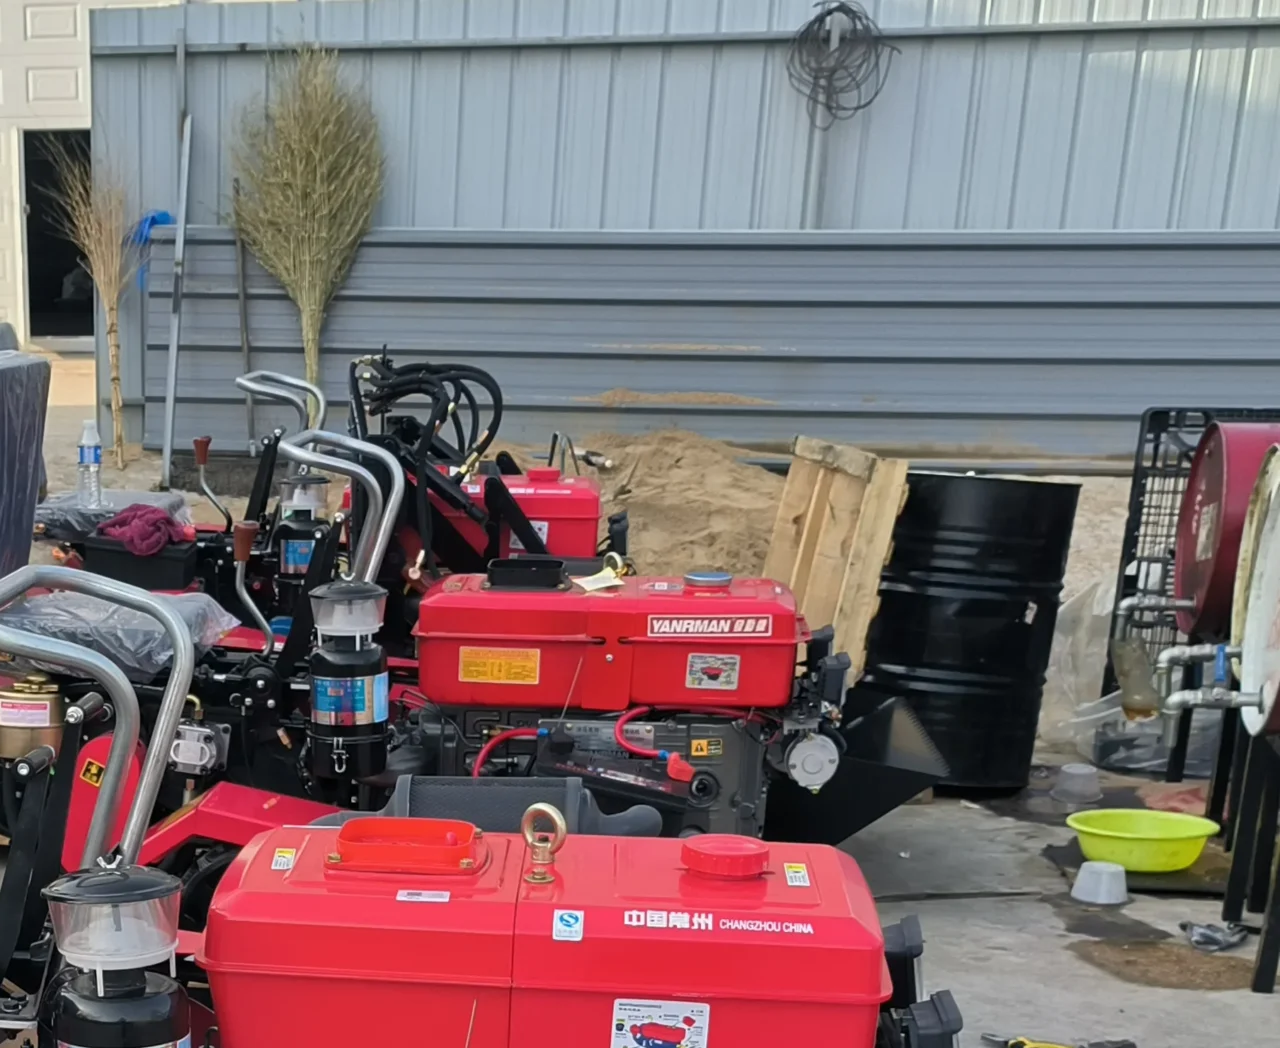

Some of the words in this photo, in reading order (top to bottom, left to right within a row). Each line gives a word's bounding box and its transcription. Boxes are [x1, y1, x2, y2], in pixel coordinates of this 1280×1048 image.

[652, 618, 731, 633] YANRMAN
[624, 909, 713, 931] 中国常州
[719, 918, 781, 933] CHANGZHOU
[782, 921, 814, 935] CHINA
